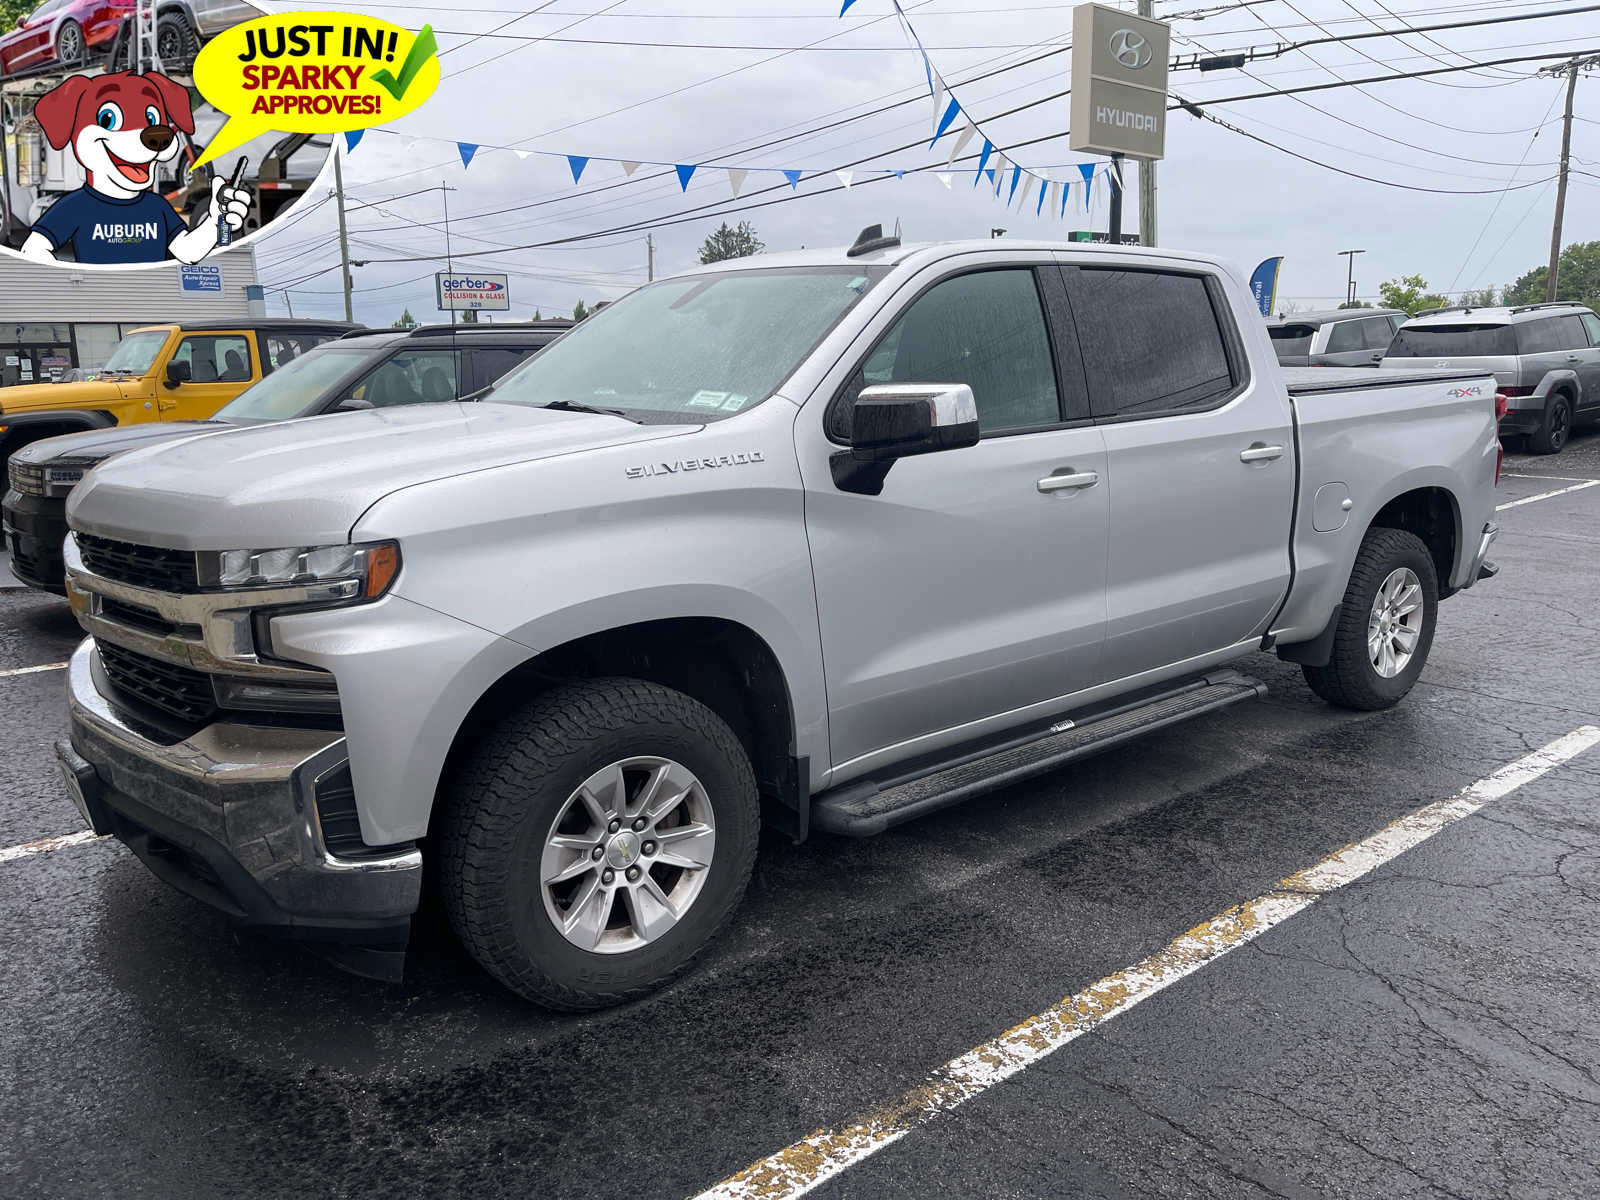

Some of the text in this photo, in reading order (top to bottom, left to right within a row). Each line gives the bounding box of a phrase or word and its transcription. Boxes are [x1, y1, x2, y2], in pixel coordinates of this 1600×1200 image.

[1096, 106, 1157, 132] HYUNDAI
[181, 265, 219, 273] GEICO
[443, 277, 489, 291] gerber
[625, 450, 765, 479] SILVERADO
